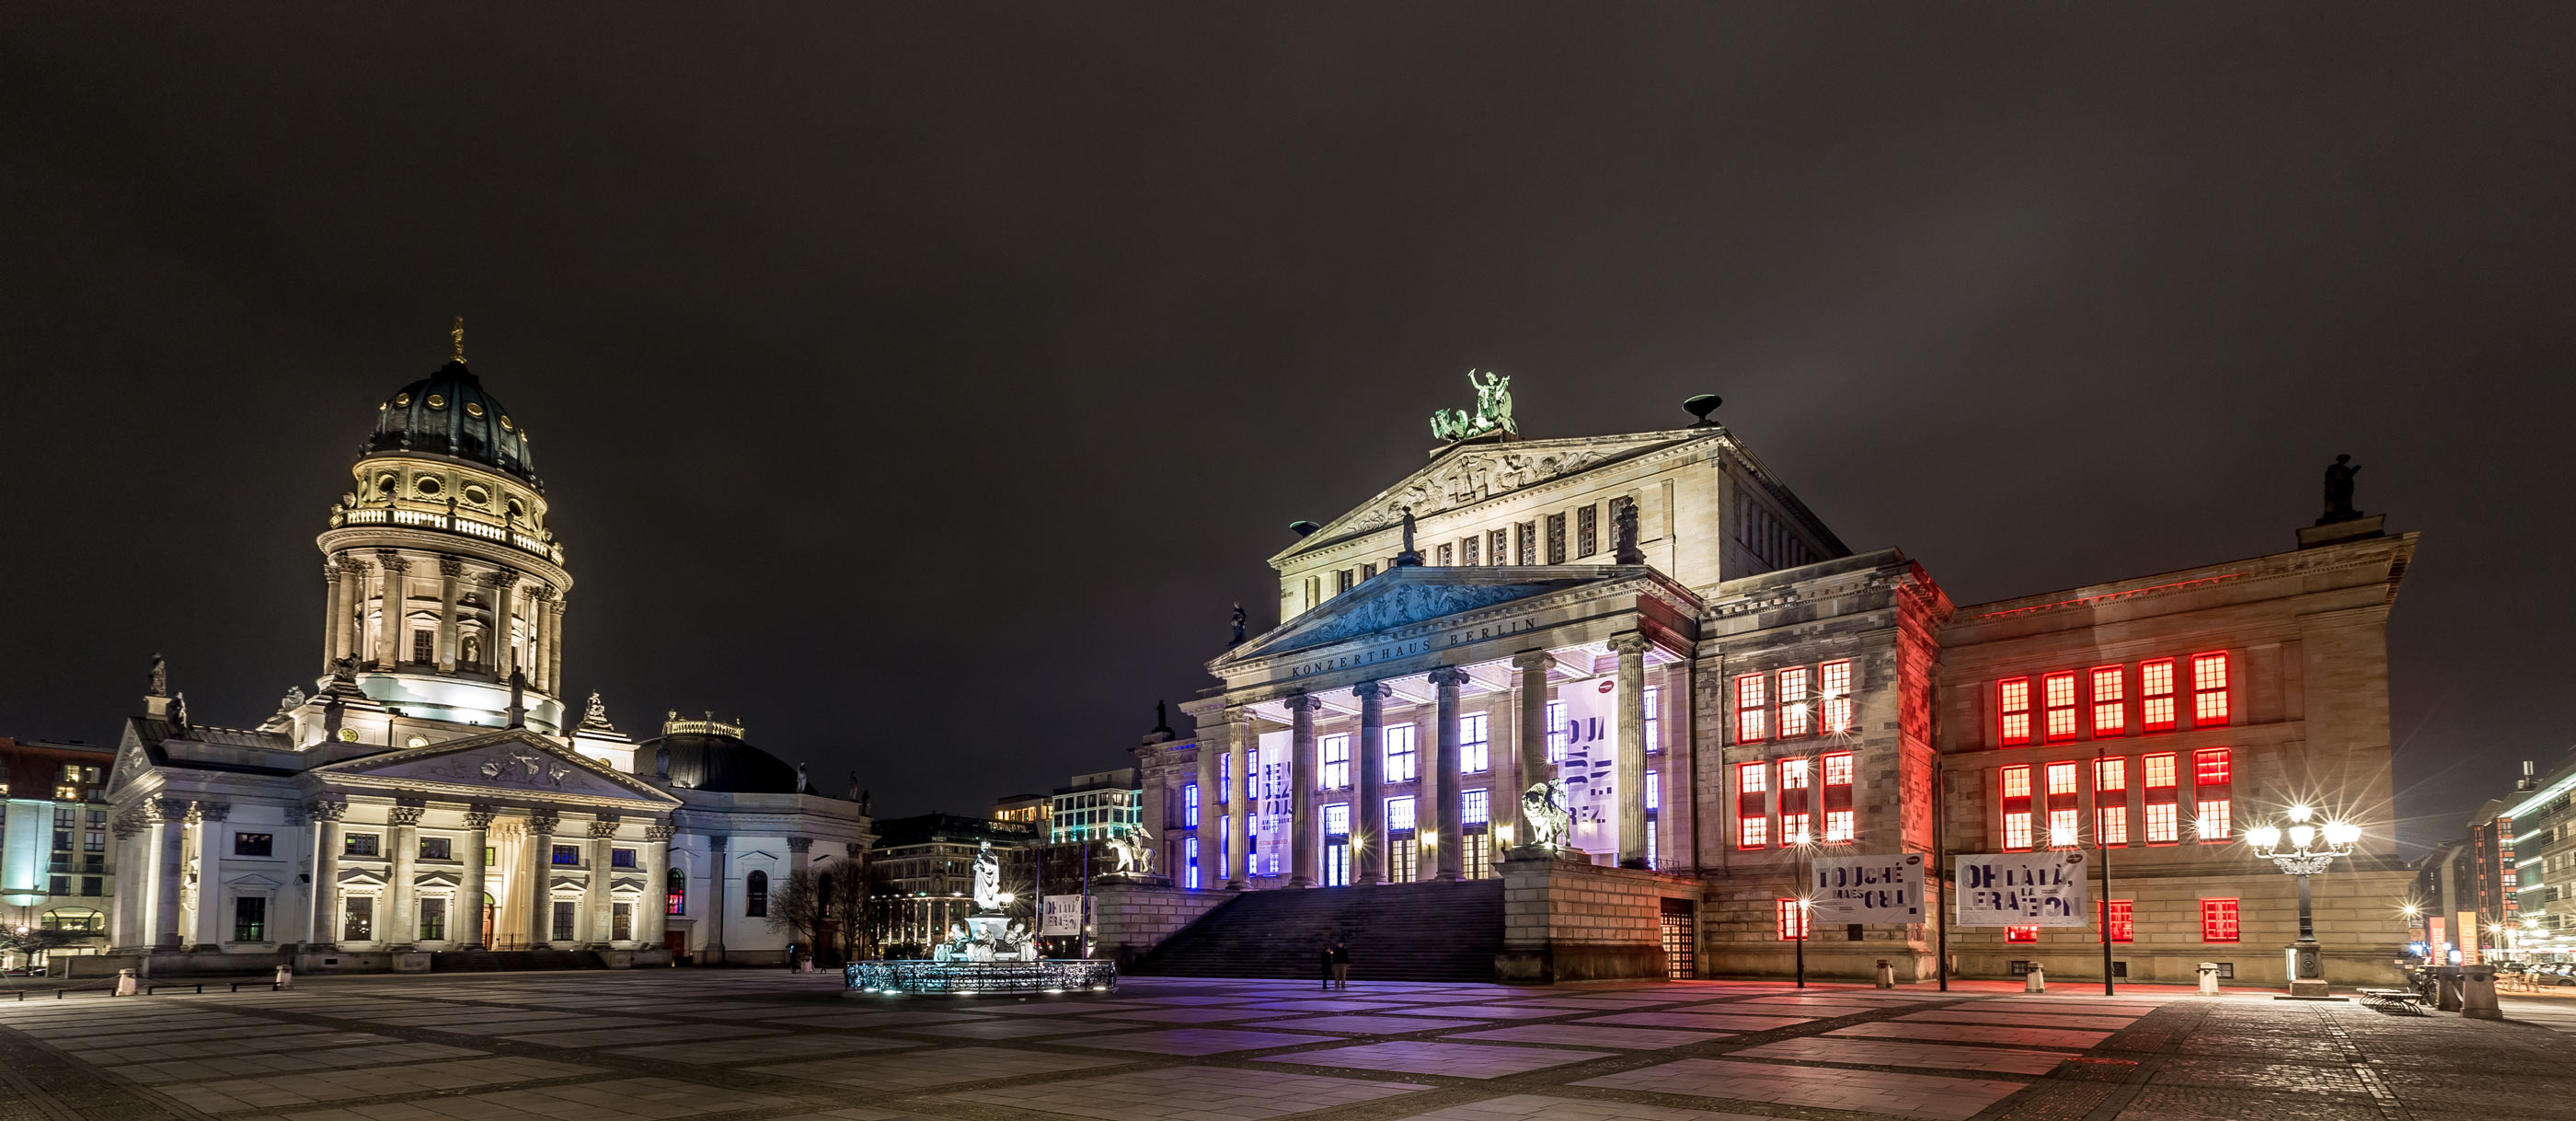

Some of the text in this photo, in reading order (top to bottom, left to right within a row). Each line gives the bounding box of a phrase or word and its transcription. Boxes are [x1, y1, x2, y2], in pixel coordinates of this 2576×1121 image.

[1291, 617, 1536, 677] KONZERTHAUS BERLIN
[1816, 862, 1903, 887] TOUCHÉ
[1961, 864, 2004, 888] OH
